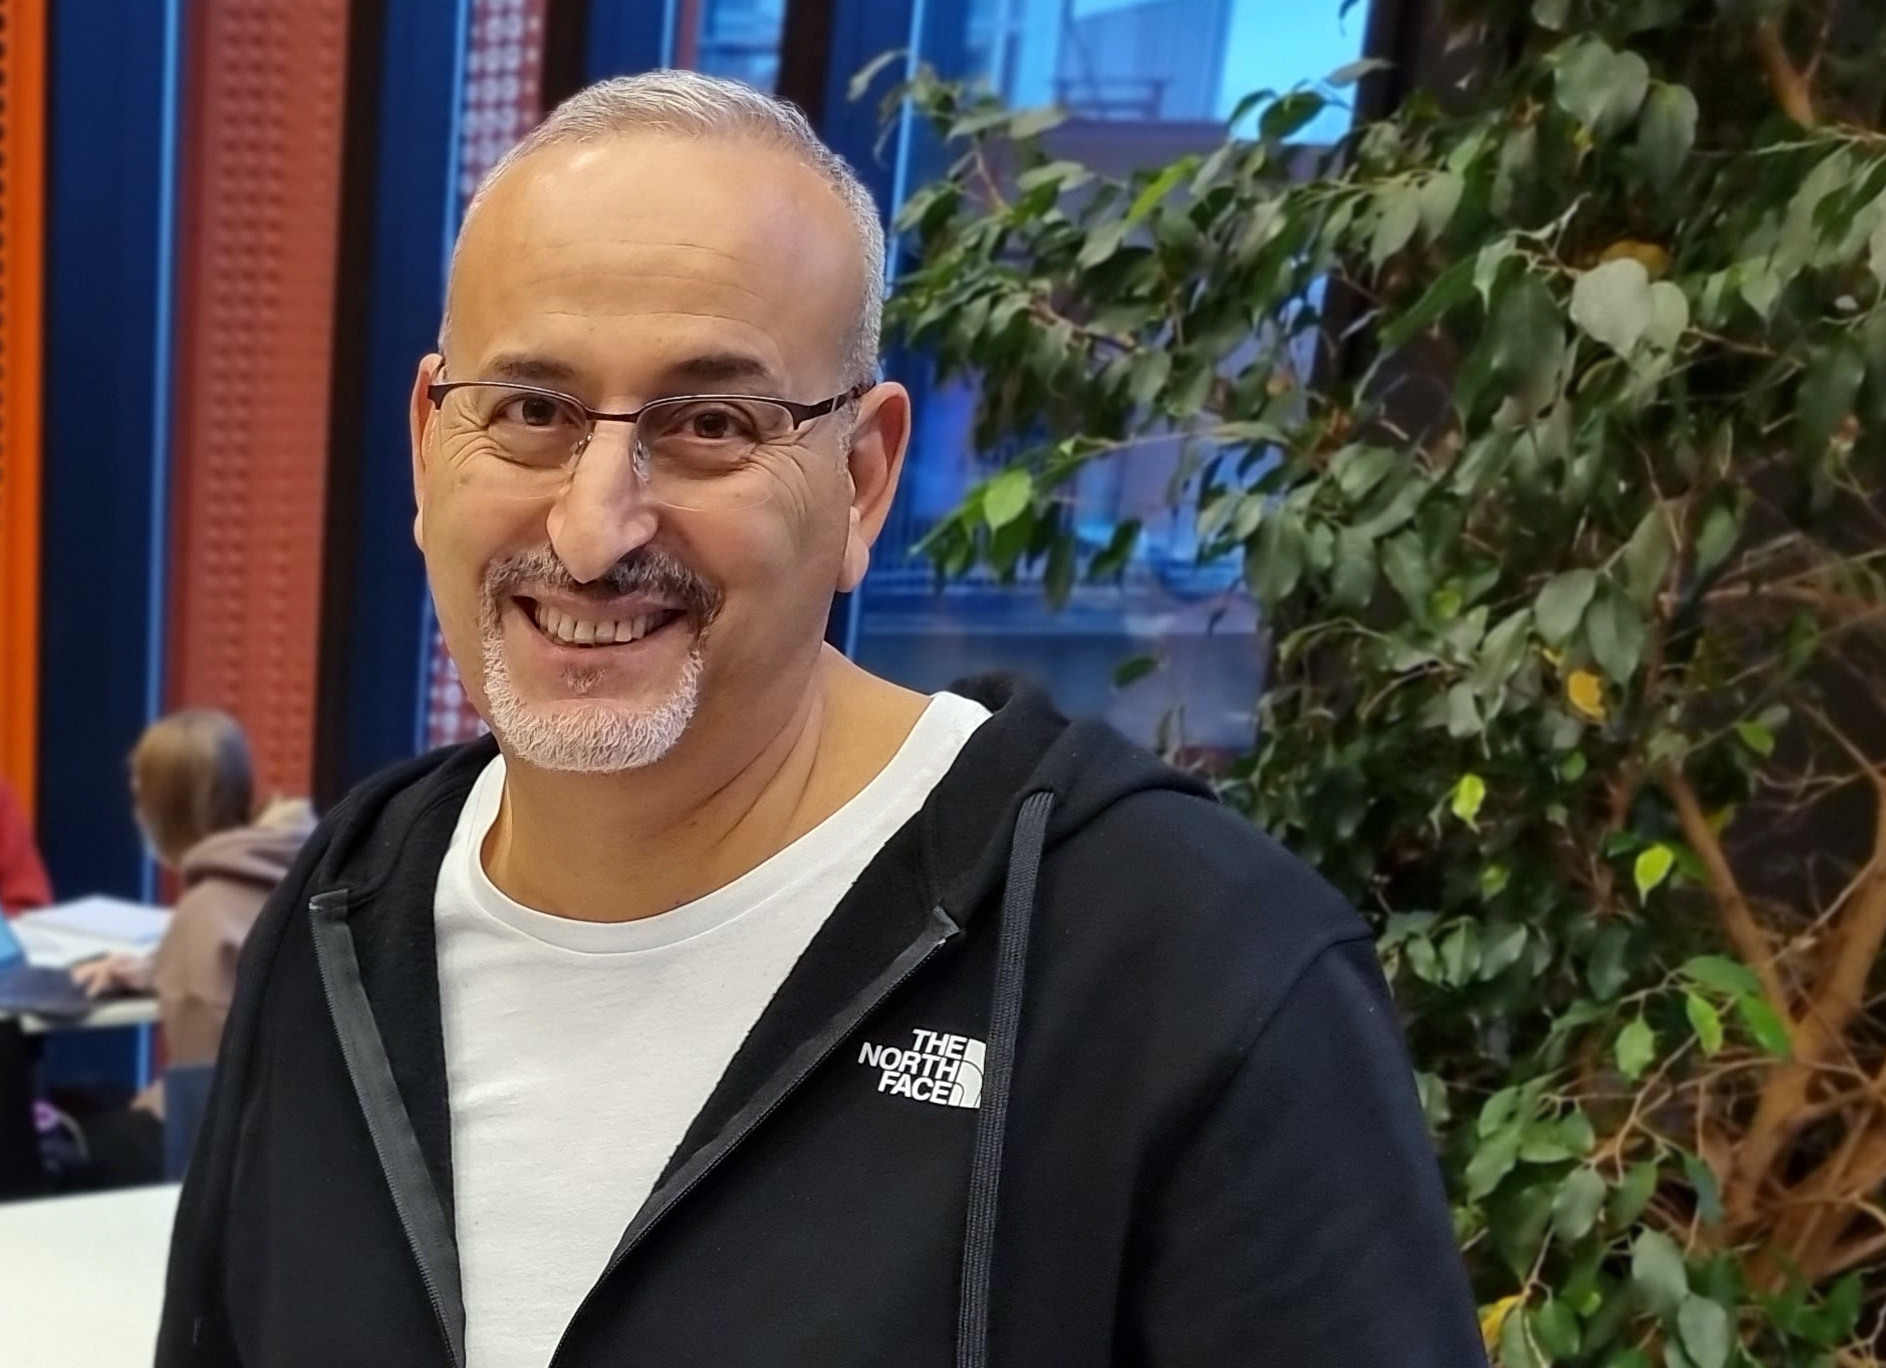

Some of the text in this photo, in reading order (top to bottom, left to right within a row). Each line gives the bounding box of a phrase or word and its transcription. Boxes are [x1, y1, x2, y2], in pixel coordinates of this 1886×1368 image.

[912, 1028, 967, 1060] THE
[857, 1041, 961, 1083] NORTH
[877, 1070, 953, 1105] FACE
